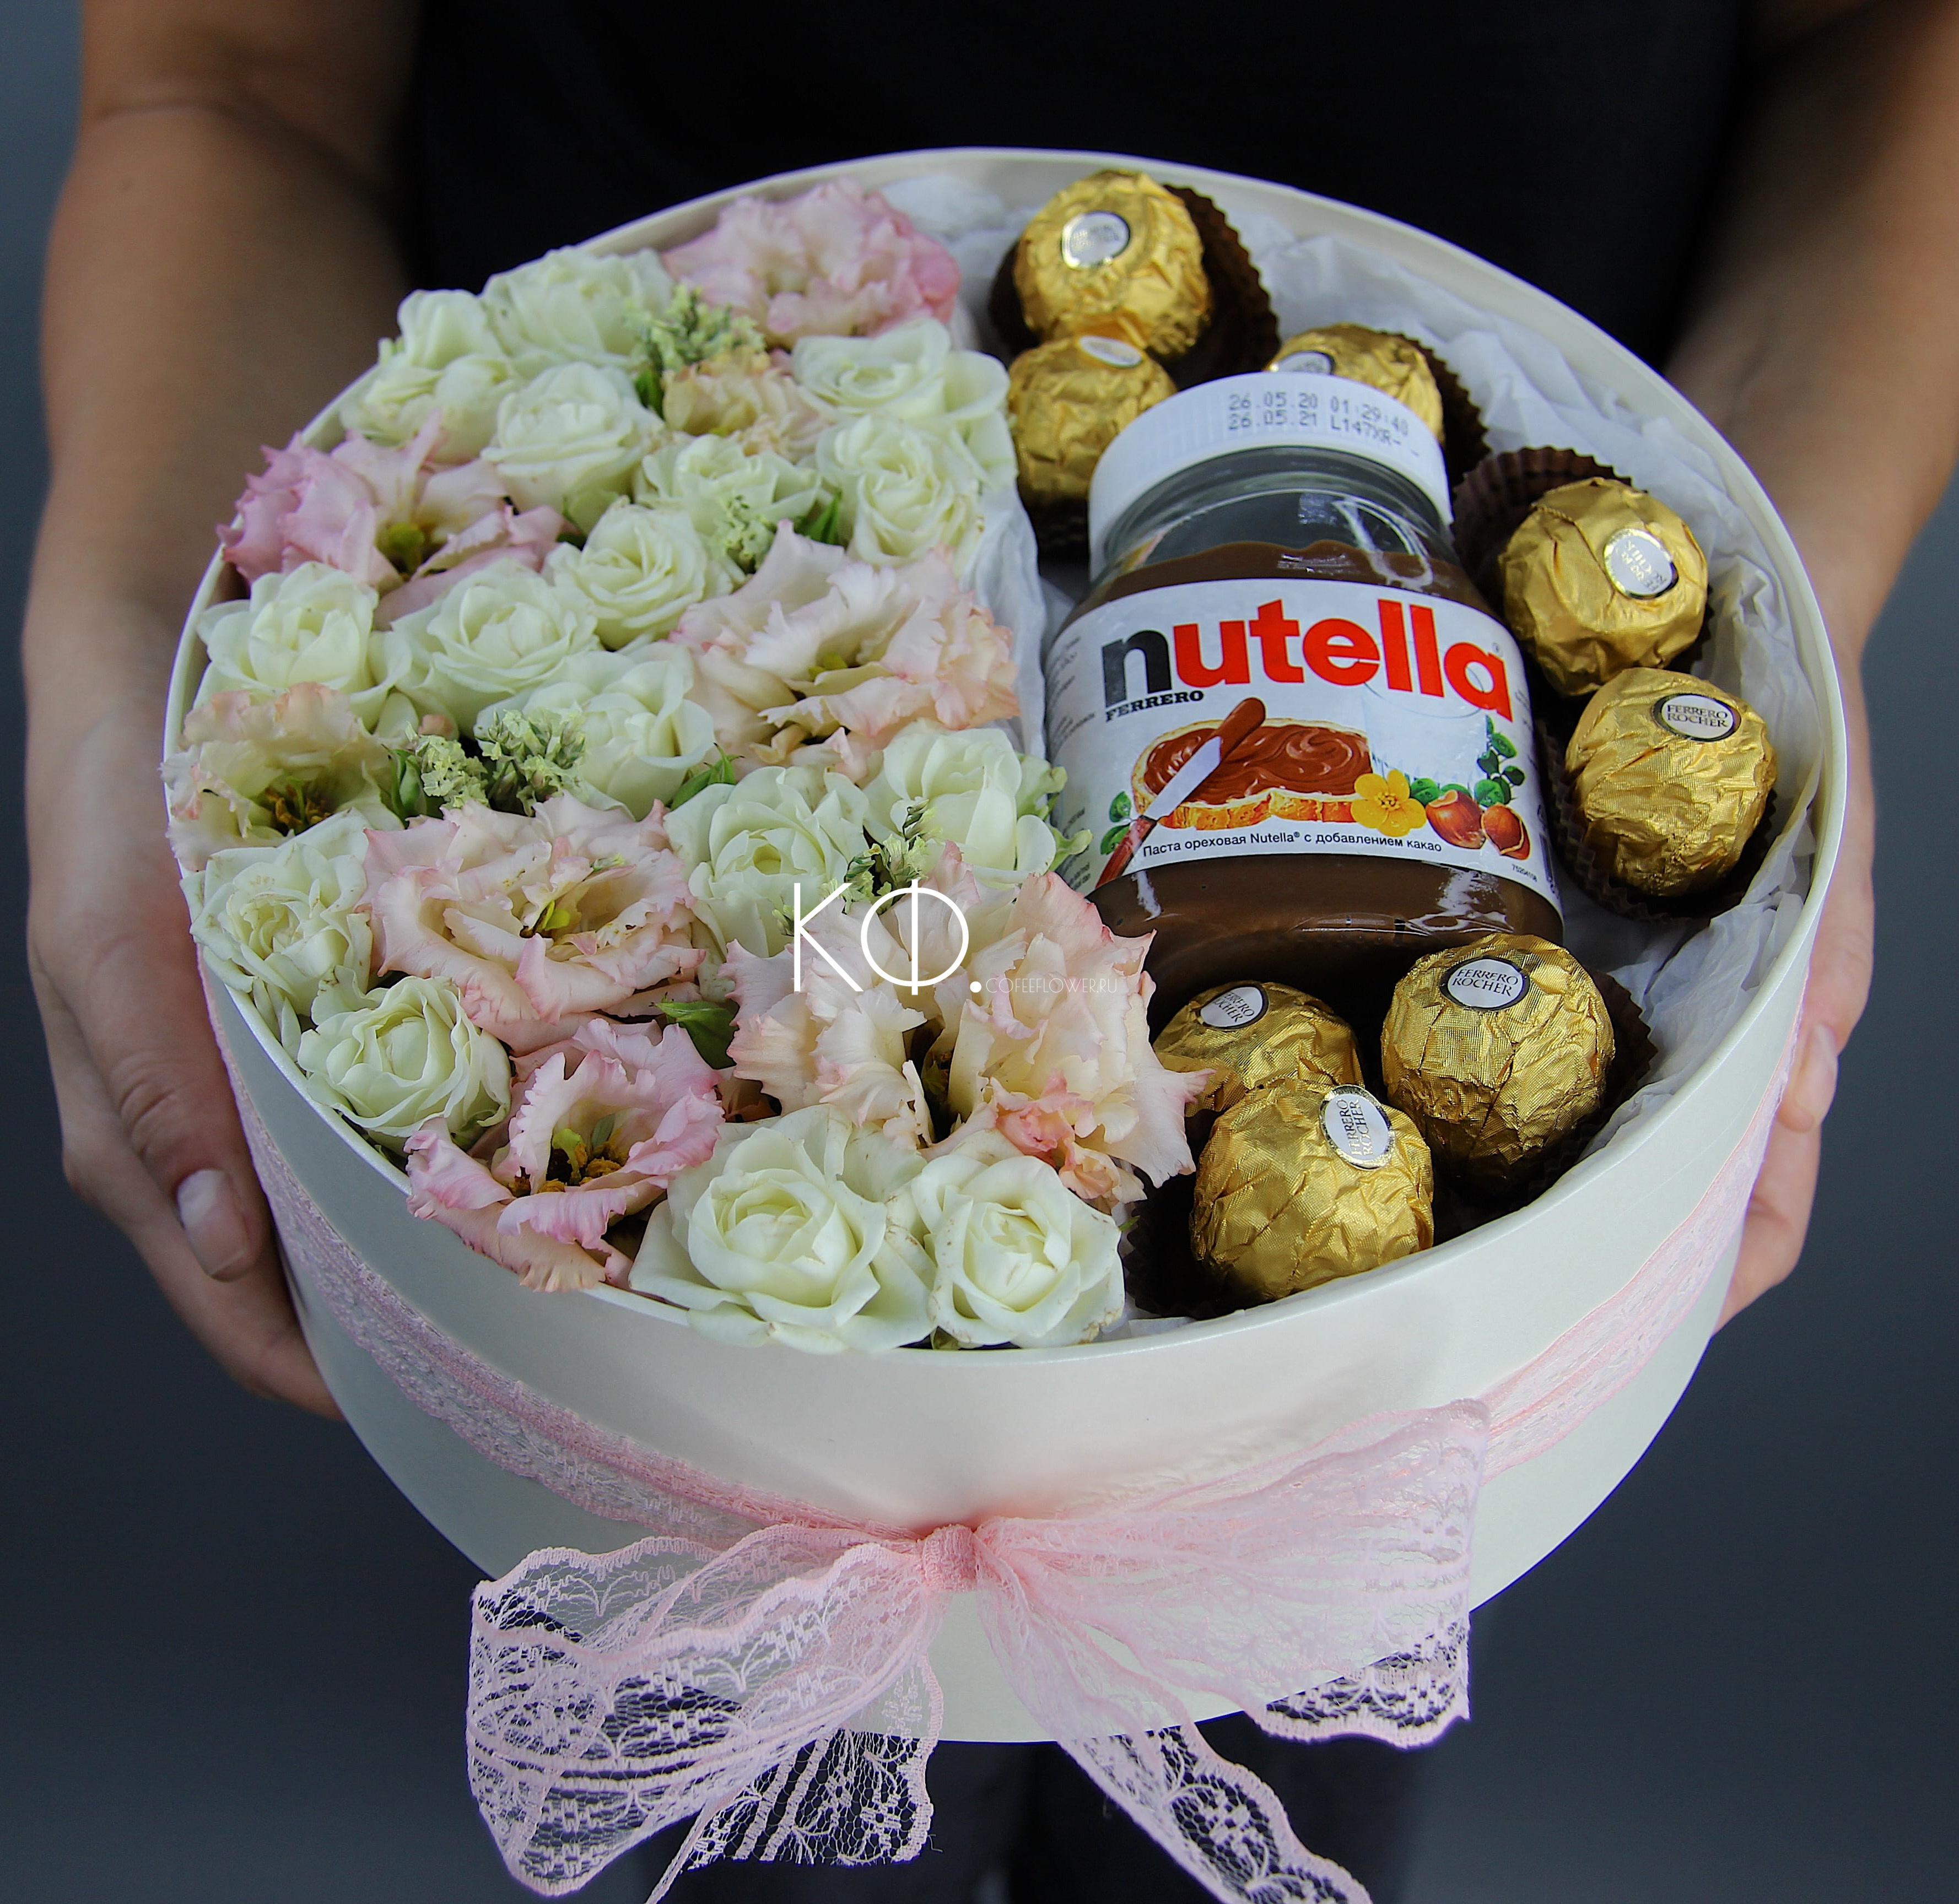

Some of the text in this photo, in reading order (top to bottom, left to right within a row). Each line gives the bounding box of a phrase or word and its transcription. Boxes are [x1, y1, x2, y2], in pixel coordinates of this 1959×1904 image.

[1102, 599, 1513, 722] nutella
[1106, 690, 1204, 722] FERRERO
[1667, 705, 1728, 719] FERRERO
[1667, 713, 1728, 727] ROCHER
[1143, 842, 1181, 857] Паста
[1185, 835, 1246, 851] ореховая
[1304, 834, 1312, 842] с
[1315, 832, 1403, 847] добавлением
[1407, 839, 1442, 852] какао
[1452, 977, 1512, 997] ROCHER
[1457, 969, 1518, 986] FERRERO
[1350, 1099, 1373, 1156] ROCHER
